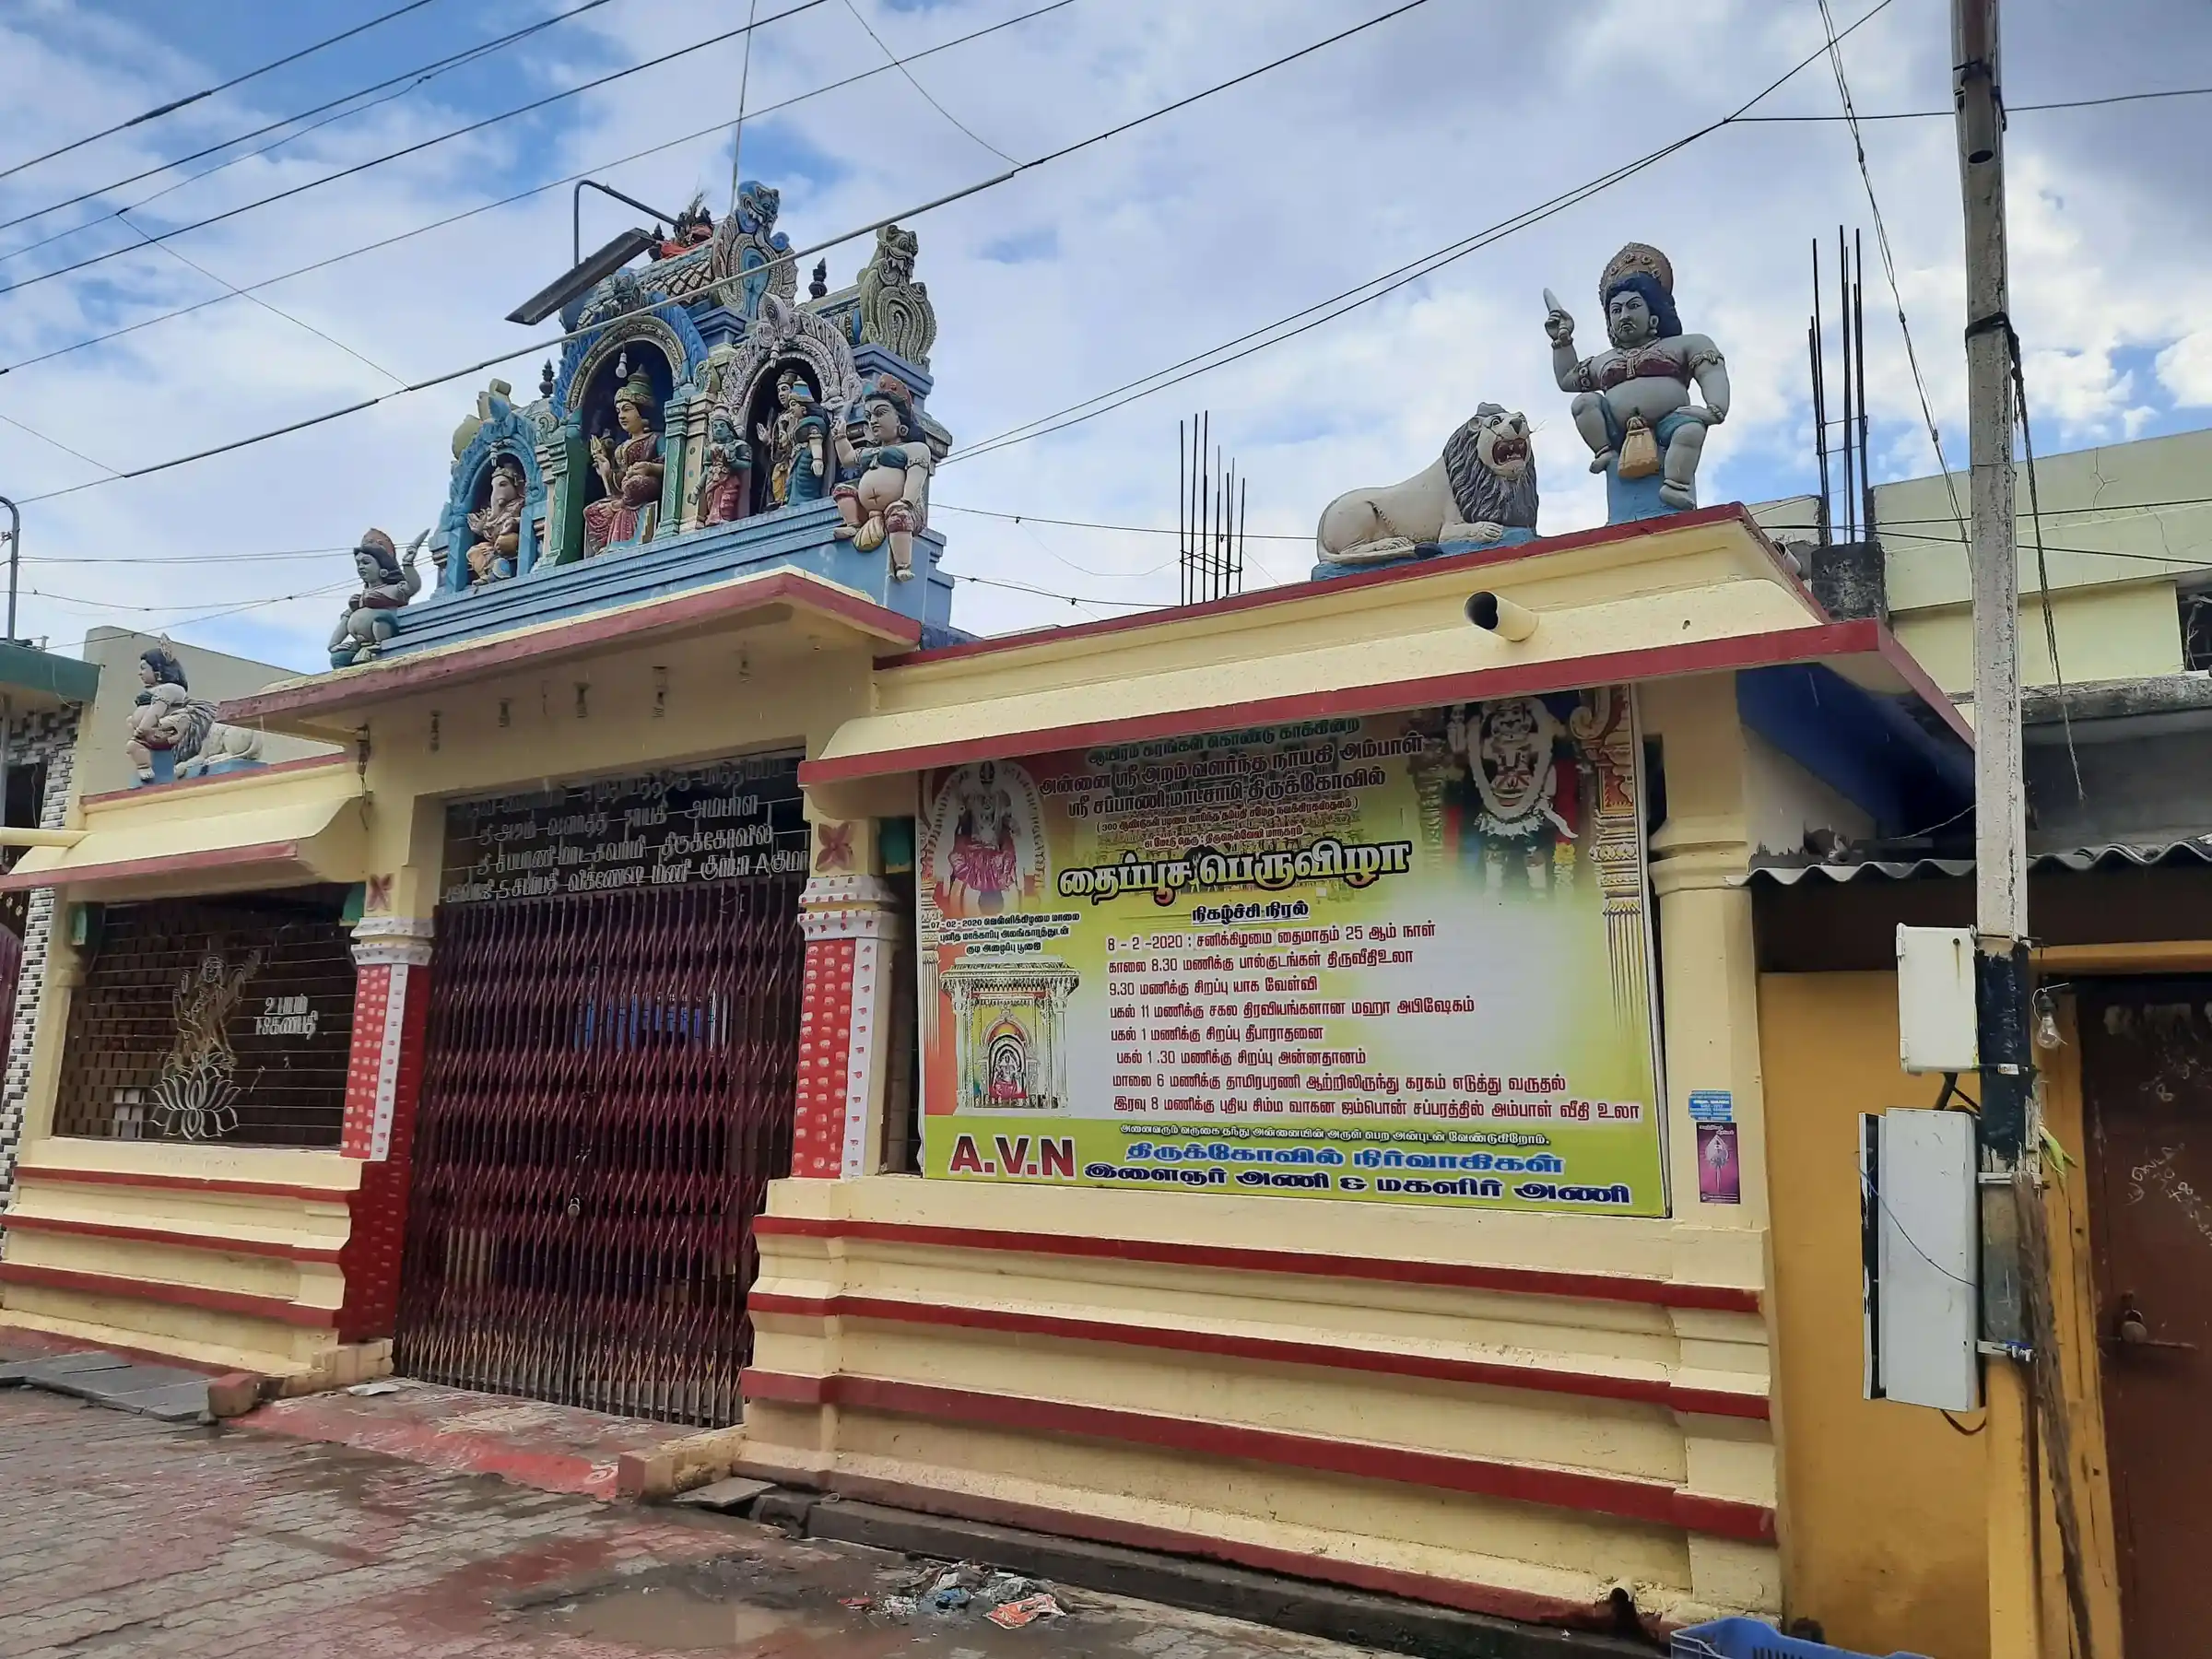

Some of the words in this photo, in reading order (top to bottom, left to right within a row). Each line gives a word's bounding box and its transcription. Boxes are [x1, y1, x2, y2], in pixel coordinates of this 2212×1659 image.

[1040, 772, 1112, 794] அன்னை
[1142, 760, 1187, 784] அறம்
[1192, 751, 1267, 775] வளர்ந்த
[1273, 743, 1334, 771] நாயகி
[1339, 731, 1424, 761] அம்பாள்
[1093, 790, 1165, 815] சப்பாணி
[1248, 765, 1385, 802] திருக்கோவில்
[1057, 851, 1196, 907] தைப்பூச
[1196, 836, 1412, 890] பெருவிழா
[1052, 912, 1080, 923] மாலை
[1192, 900, 1262, 923] நிகழ்ச்சி
[1265, 899, 1310, 920] நிரல்
[1196, 930, 1272, 948] சனிக்கிழமை
[1278, 924, 1340, 945] தைமாதம்
[1346, 925, 1363, 940] 25
[1369, 922, 1396, 941] ஆம்
[1403, 920, 1436, 938] நாள்
[1109, 959, 1147, 974] காலை
[1151, 958, 1177, 972] 8.30
[1182, 953, 1234, 971] மணிக்கு
[1240, 950, 1322, 970] பால்குடங்கள்
[1109, 982, 1135, 996] 9.30
[1139, 979, 1189, 996] மணிக்கு
[1194, 978, 1229, 995] சிறப்பு
[1233, 978, 1260, 994] யாக
[1265, 974, 1318, 992] வேள்வி
[1110, 1003, 1136, 1019] பகல்
[1140, 1005, 1150, 1018] 11
[1154, 1001, 1206, 1019] மணிக்கு
[1209, 1004, 1238, 1018] சகல
[1242, 999, 1347, 1019] திரவியங்களான
[1351, 1000, 1391, 1017] மஹா
[1397, 995, 1475, 1015] அபிஷேகம்
[1111, 1026, 1136, 1041] பகல்
[1141, 1028, 1147, 1041] 1
[1150, 1024, 1201, 1042] மணிக்கு
[1206, 1024, 1241, 1042] சிறப்பு
[1245, 1025, 1324, 1042] தீபாராதனை
[1116, 1048, 1143, 1065] பகல்
[1181, 1047, 1232, 1066] மணிக்கு
[1237, 1048, 1274, 1066] சிறப்பு
[1278, 1047, 1367, 1067] அன்னதானம்
[1112, 1073, 1152, 1088] மாலை
[1157, 1073, 1165, 1088] 6
[1170, 1071, 1221, 1090] மணிக்கு
[1226, 1072, 1301, 1091] தாமிரபரணி
[1306, 1072, 1400, 1095] ஆற்றிலிருந்து
[1406, 1073, 1447, 1093] கரகம்
[1453, 1072, 1502, 1096] எடுத்து
[1508, 1073, 1567, 1094] வருதல்
[1113, 1095, 1147, 1112] இரவு
[1151, 1096, 1159, 1111] 8
[1164, 1094, 1215, 1113] மணிக்கு
[1219, 1097, 1248, 1113] புதிய
[1253, 1095, 1284, 1113] சிம்ம
[1289, 1100, 1335, 1115] வாகன
[1413, 1098, 1485, 1119] சப்பரத்தில்
[1491, 1099, 1553, 1118] அம்பாள்
[1559, 1100, 1590, 1121] வீதி
[1120, 1124, 1179, 1136] அனைவரும்
[1180, 1125, 1220, 1138] வருகை
[1221, 1124, 1250, 1139] தந்து
[1252, 1126, 1325, 1141] அன்னையின்
[1327, 1128, 1362, 1141] அருள்
[1364, 1129, 1390, 1143] பெற
[1392, 1130, 1446, 1144] அன்புடன்
[949, 1133, 1077, 1180] A.V.N
[1125, 1141, 1345, 1167] திருக்கோவில்
[1352, 1147, 1566, 1174] நிர்வாகிகள்
[1085, 1162, 1228, 1187] இளைஞர்
[1236, 1171, 1330, 1191] அணி
[1376, 1174, 1504, 1197] மகளிர்
[1512, 1182, 1631, 1205] அணி
